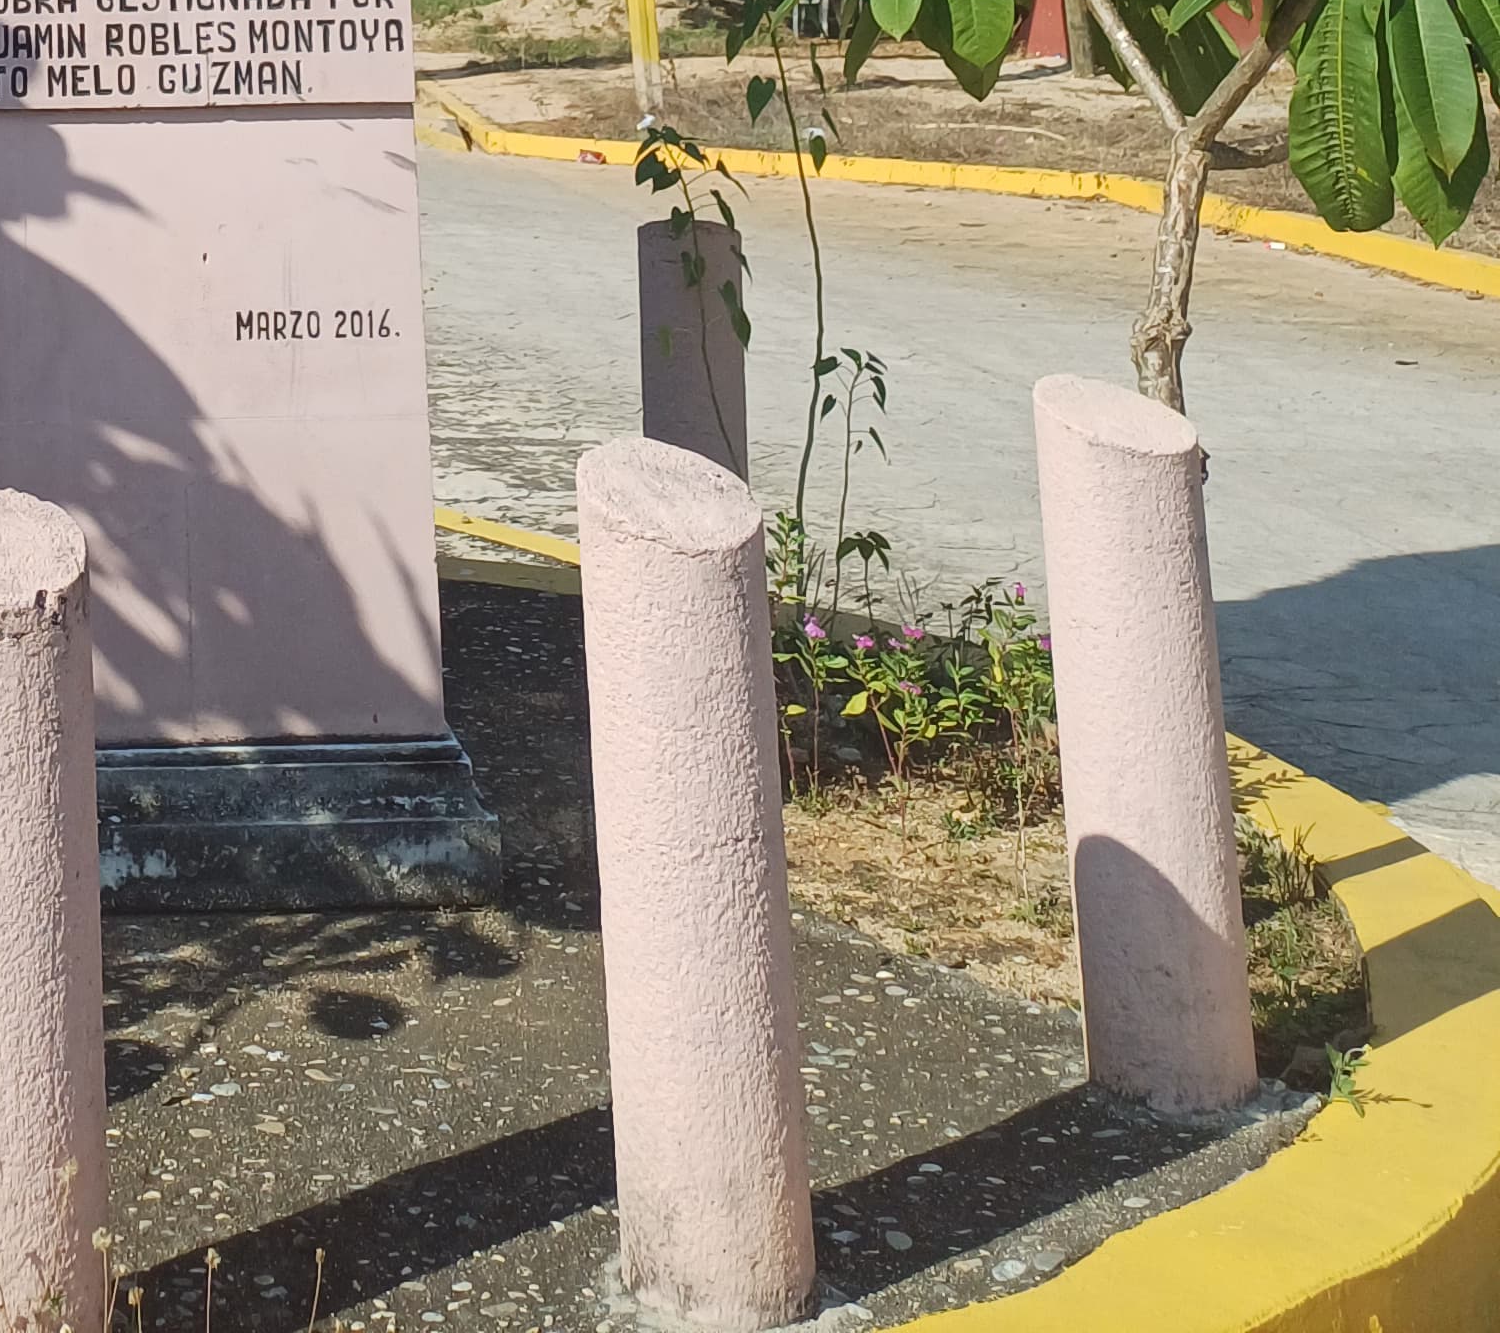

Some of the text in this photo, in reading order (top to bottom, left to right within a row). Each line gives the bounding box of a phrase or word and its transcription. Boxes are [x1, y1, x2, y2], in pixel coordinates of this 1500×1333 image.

[104, 20, 237, 57] ROBLES
[248, 17, 406, 55] MONTOYA
[46, 63, 137, 98] MELO
[157, 59, 314, 98] GUZMAN.
[235, 308, 402, 342] MARZO 2016.
